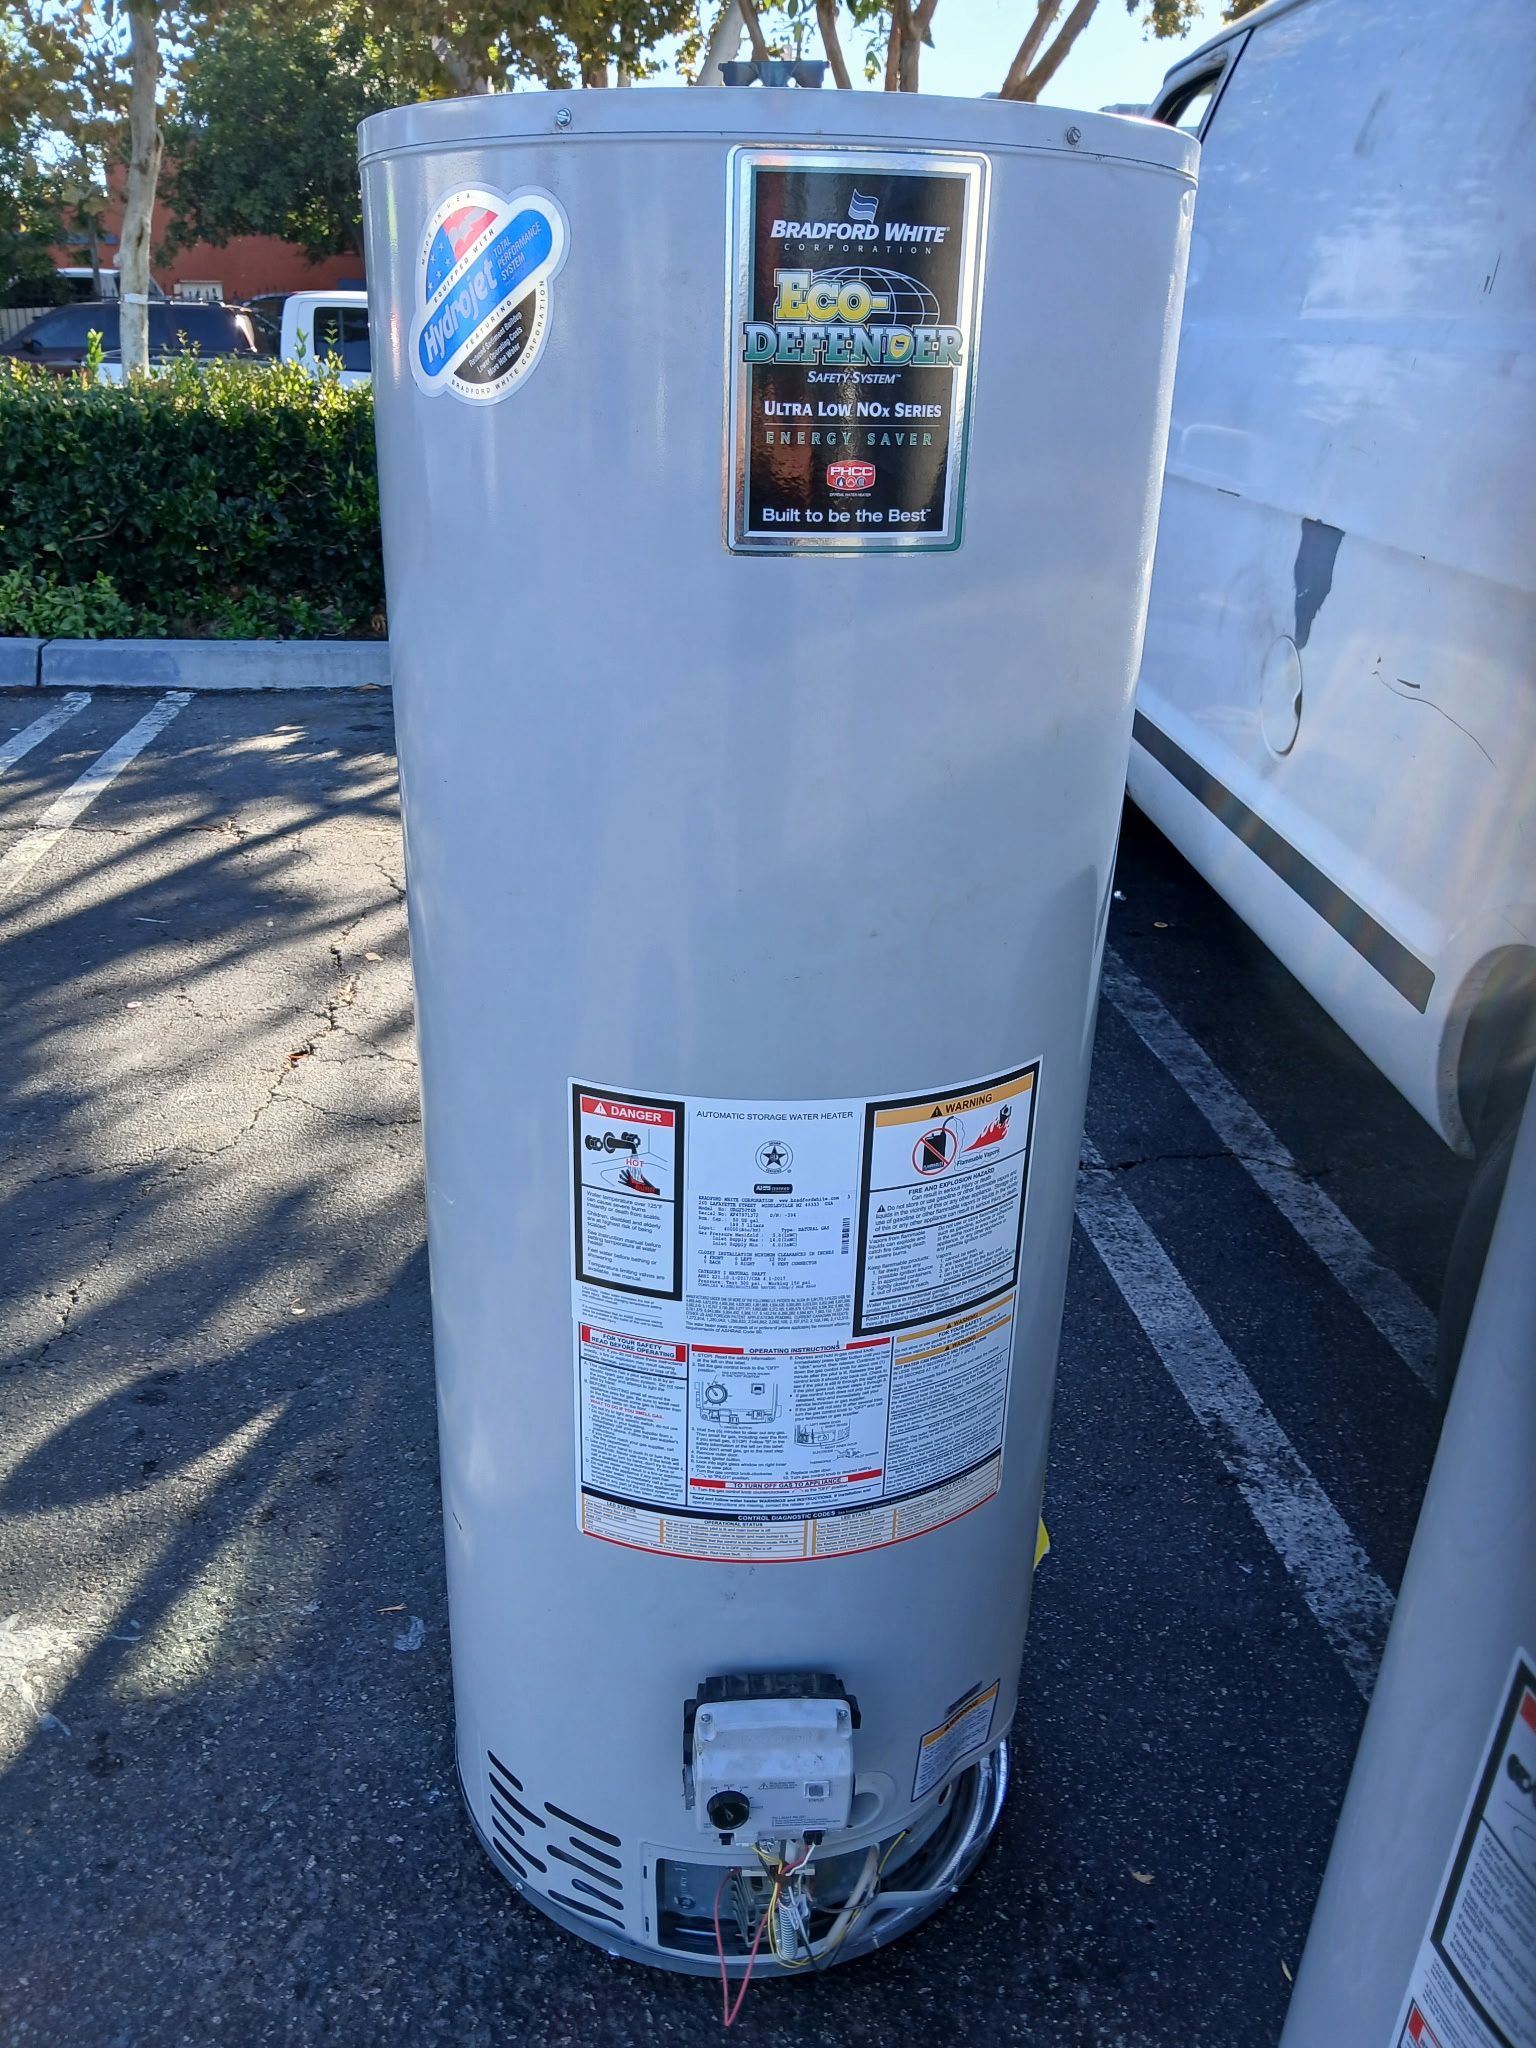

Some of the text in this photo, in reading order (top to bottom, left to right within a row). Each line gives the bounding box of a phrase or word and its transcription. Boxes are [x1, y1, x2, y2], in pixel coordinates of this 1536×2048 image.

[771, 220, 947, 243] BRADFORD WHITE
[493, 236, 512, 256] TOTAL
[497, 222, 542, 269] PERFORMANCE
[784, 244, 932, 255] CORPORATION
[434, 229, 495, 303] EQUIPPED WITH
[501, 253, 525, 281] SYSTEM
[424, 259, 498, 364] Hydrojet
[466, 300, 512, 350] FEATURING
[451, 280, 545, 395] BRADFORD WHITE CORPORATION
[509, 327, 523, 341] Costs
[743, 322, 963, 367] DEFENDER
[487, 343, 521, 377] More Hot Water
[807, 371, 850, 384] SAFETY
[764, 401, 813, 417] ULTRA
[818, 401, 853, 417] LOW
[895, 403, 942, 418] SERIES
[766, 432, 932, 446] ENERGY SAVER
[830, 466, 874, 476] PHCC
[762, 509, 801, 522] Built
[805, 510, 823, 523] to
[829, 509, 850, 523] be
[856, 509, 883, 523] the
[945, 1094, 993, 1114] WARNING
[611, 1106, 662, 1122] DANGER
[696, 1111, 854, 1121] AUTOMATIC STORAGE WATER HEATER
[626, 1159, 644, 1167] HOT
[957, 1154, 983, 1167] Flammable
[984, 1149, 1000, 1160] Vapors
[939, 1176, 972, 1190] EXPLOSION
[973, 1168, 995, 1179] HAZARD
[603, 1195, 633, 1205] temperature
[939, 1318, 983, 1338] FOR YOUR SAFETY
[954, 1313, 979, 1327] WARNING
[592, 1337, 675, 1358] READ BEFORE OPERATING
[617, 1336, 636, 1346] YOUR
[637, 1341, 662, 1351] SAFETY
[791, 1345, 840, 1353] INSTRUCTIONS
[952, 1335, 977, 1348] WARNING
[771, 1513, 812, 1521] DIAGNOSTIC
